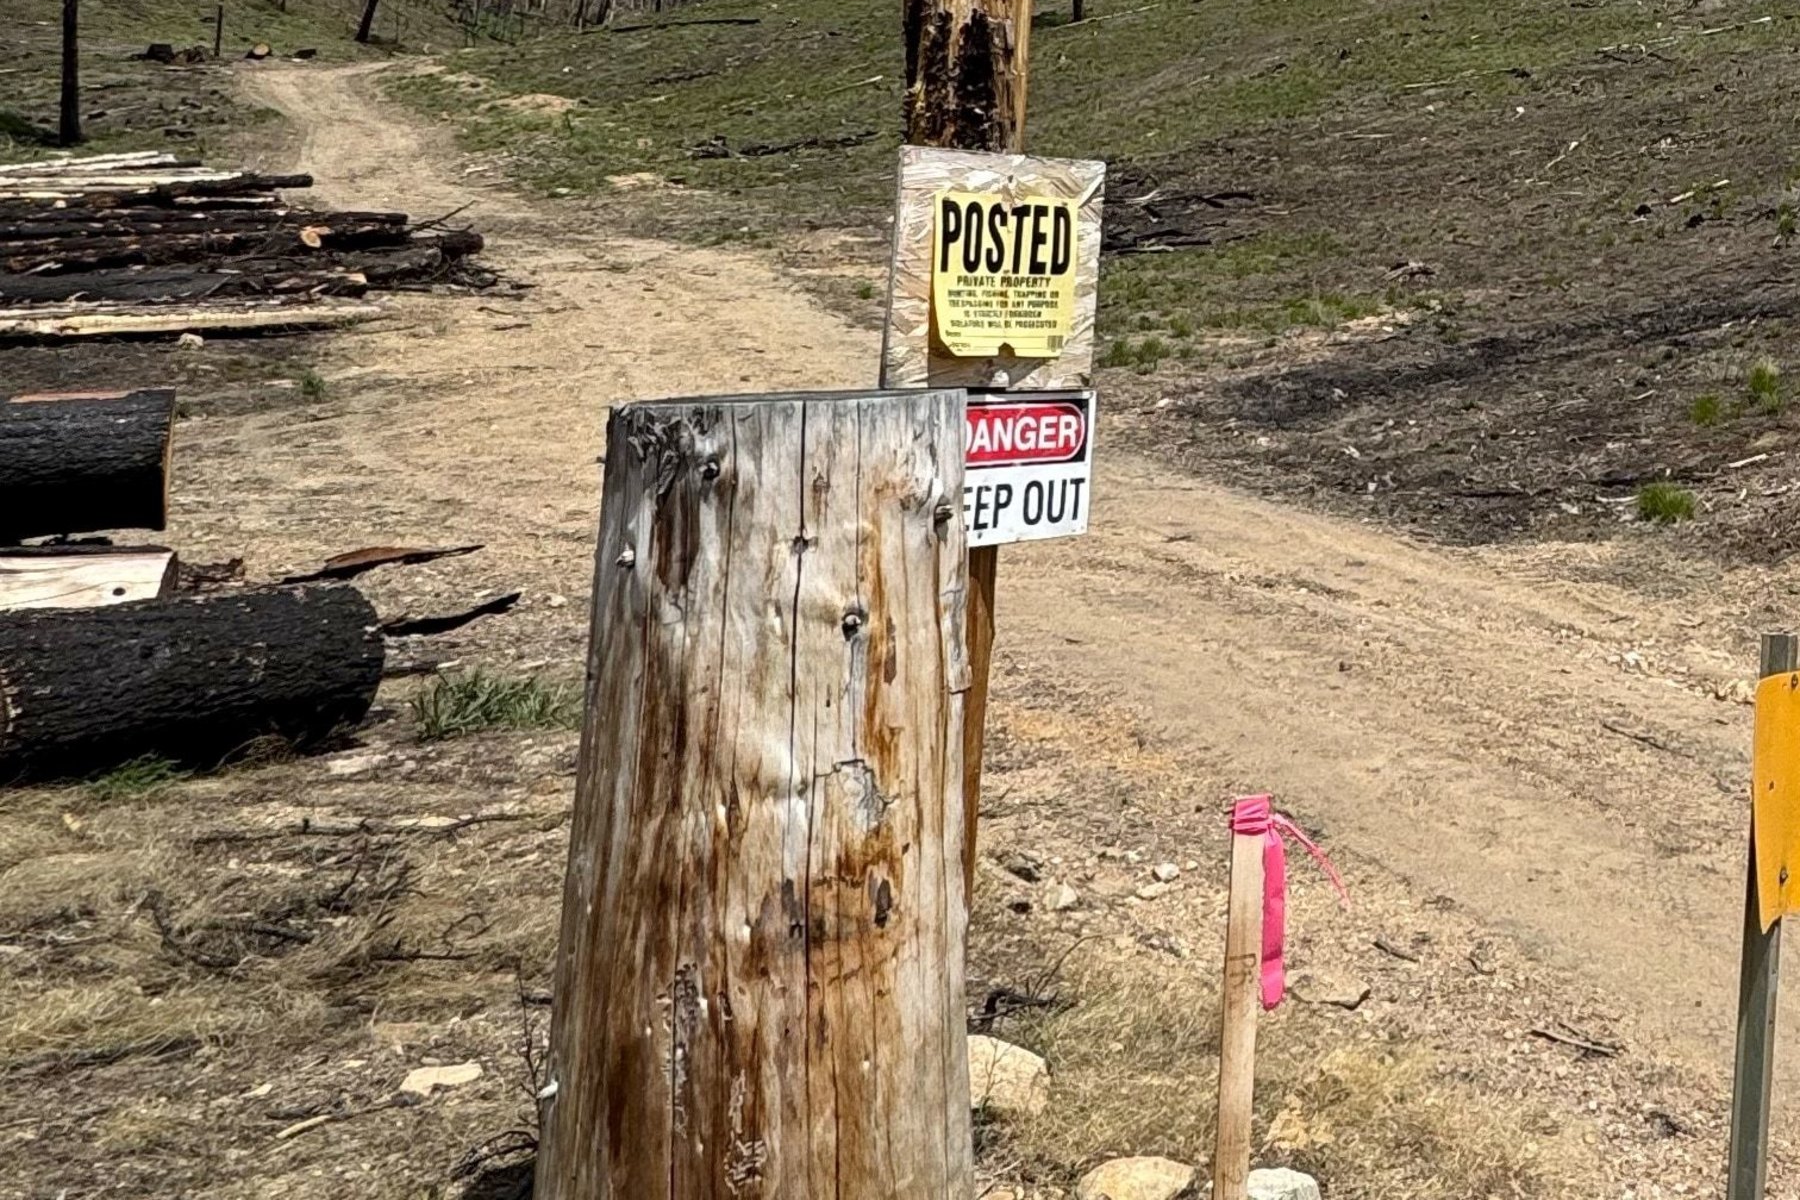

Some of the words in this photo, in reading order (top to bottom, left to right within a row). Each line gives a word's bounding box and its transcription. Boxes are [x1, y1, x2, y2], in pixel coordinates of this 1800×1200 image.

[940, 199, 1072, 275] POSTED
[957, 276, 995, 287] PRIVATE
[1000, 276, 1051, 288] PROPERTY
[1012, 300, 1024, 308] ANY
[963, 483, 1013, 531] EEP
[1023, 478, 1086, 525] OUT
